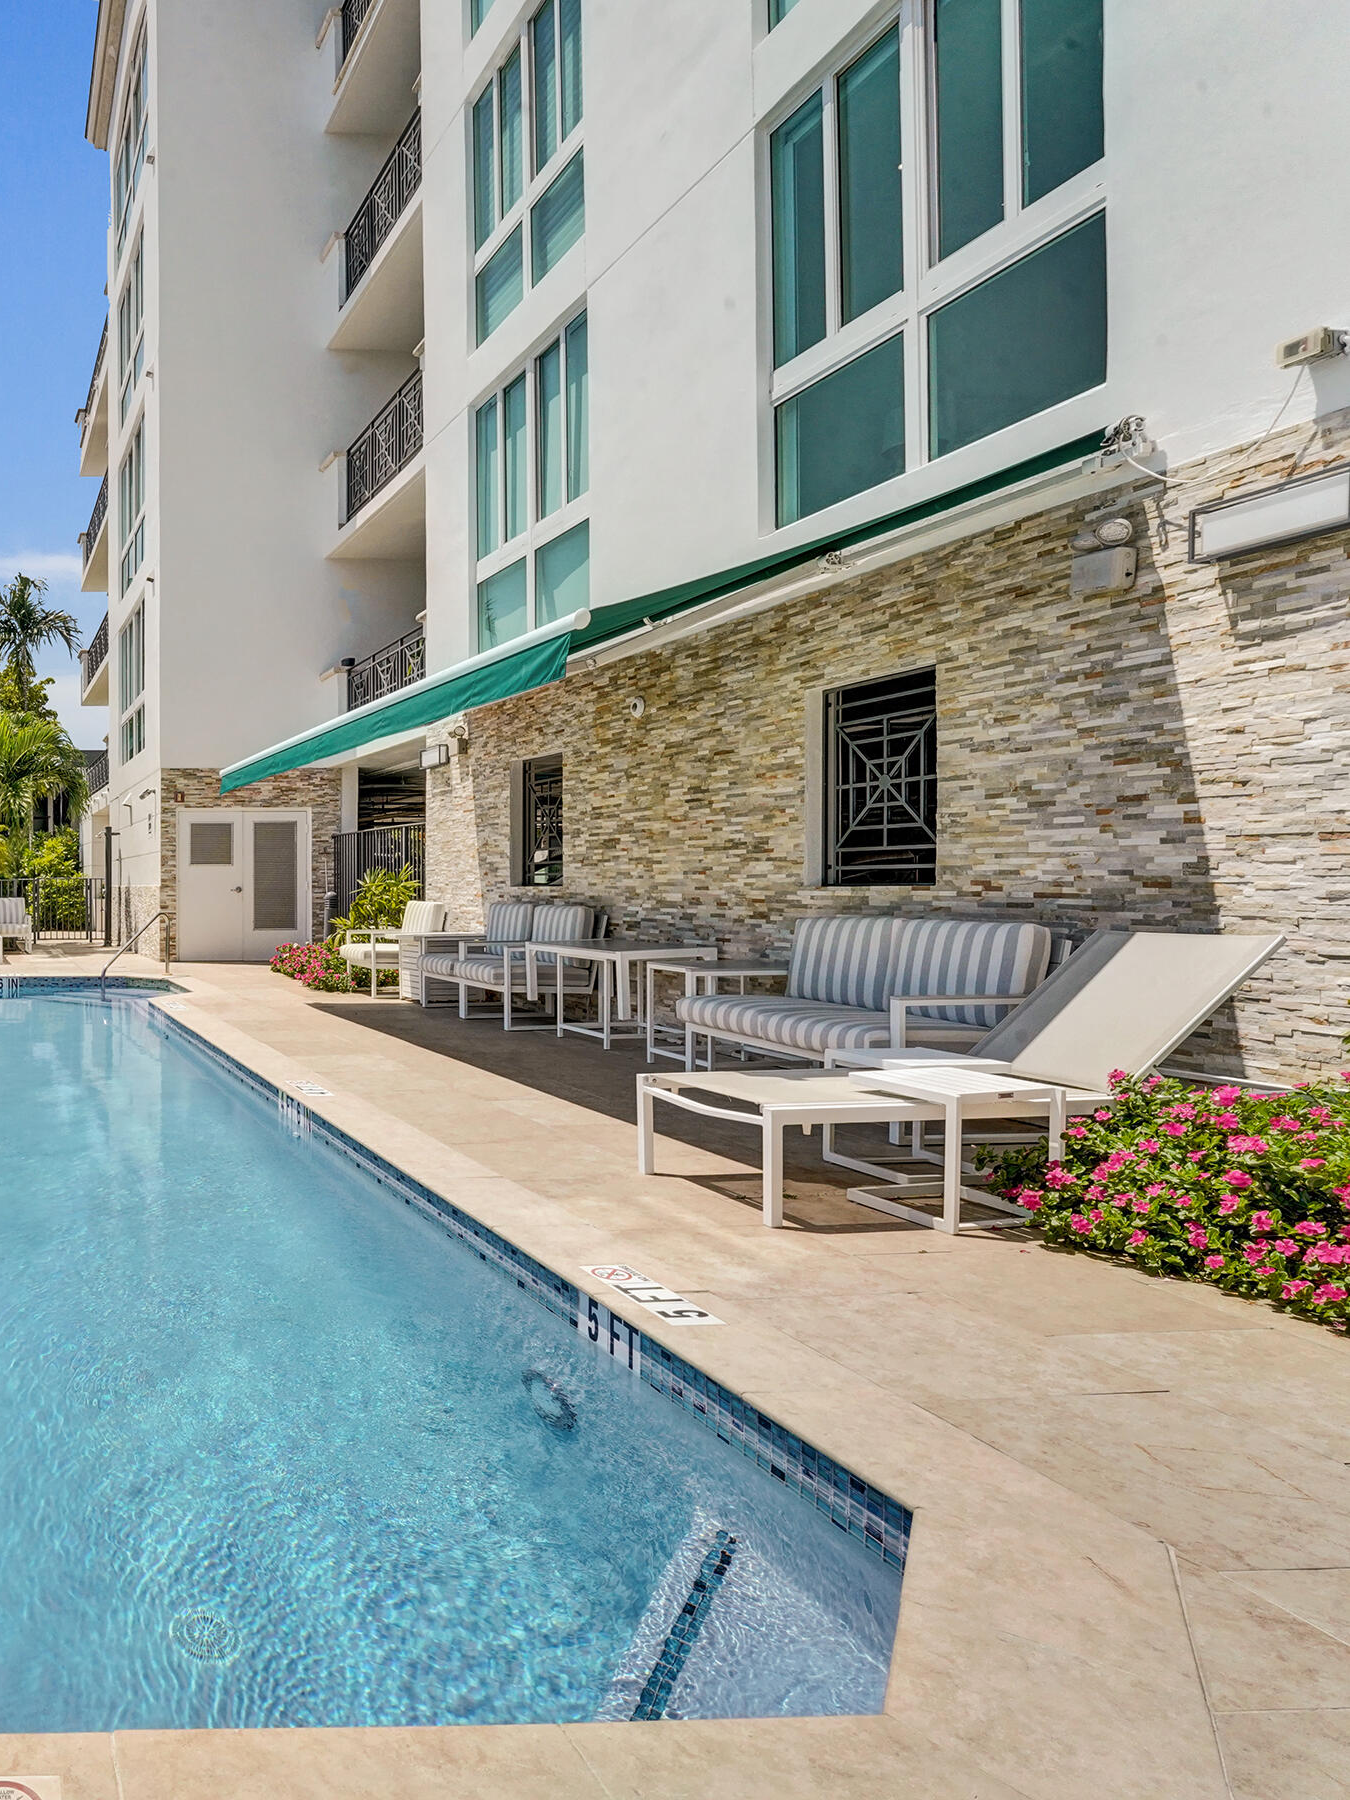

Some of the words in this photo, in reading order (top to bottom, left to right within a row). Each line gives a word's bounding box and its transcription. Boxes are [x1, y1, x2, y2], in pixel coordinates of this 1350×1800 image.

[8, 978, 18, 989] IN
[612, 1284, 685, 1303] FT
[655, 1309, 710, 1319] 5
[587, 1296, 599, 1343] 5
[609, 1310, 639, 1371] FT
